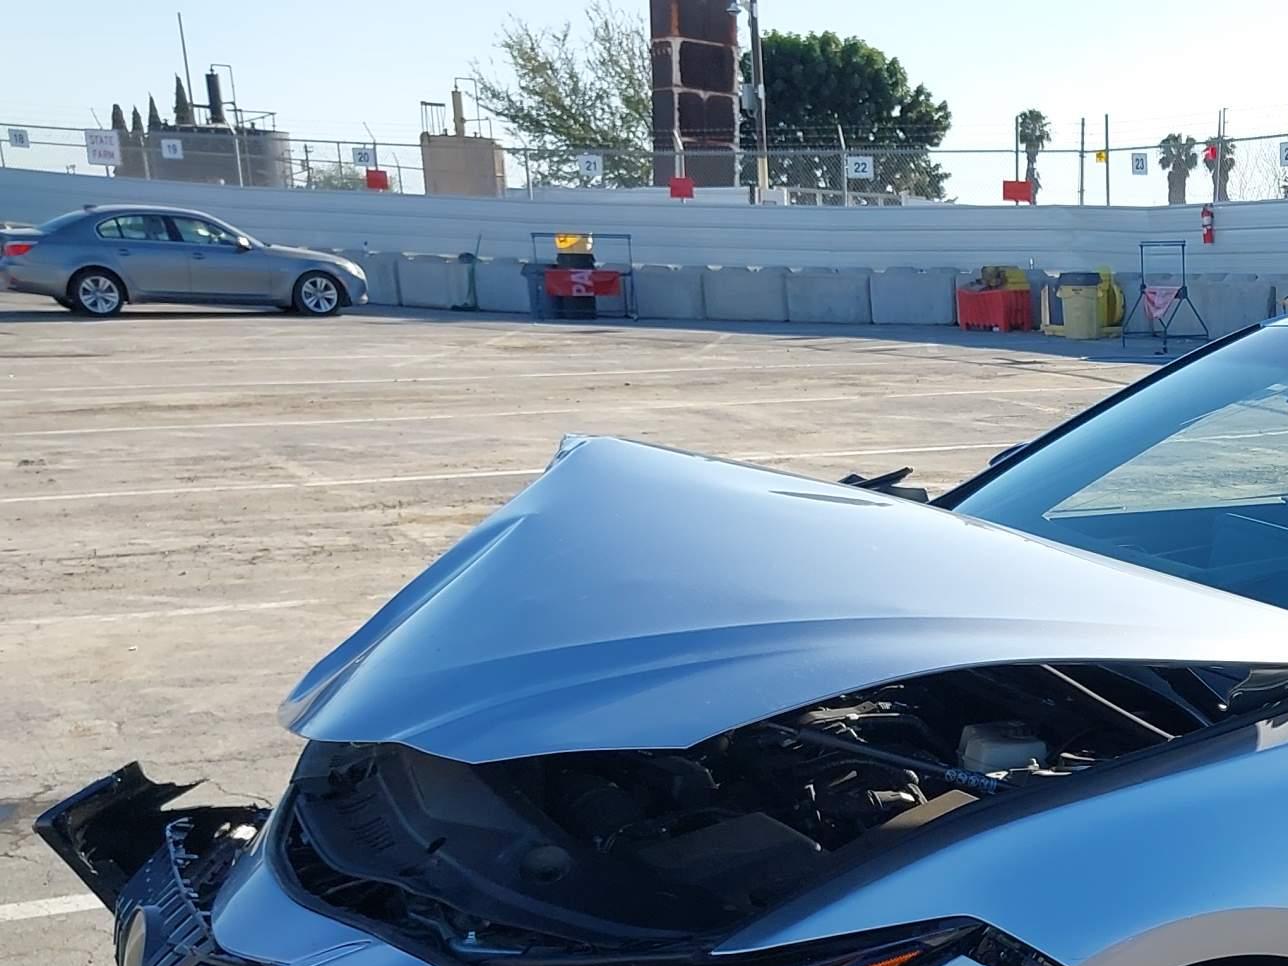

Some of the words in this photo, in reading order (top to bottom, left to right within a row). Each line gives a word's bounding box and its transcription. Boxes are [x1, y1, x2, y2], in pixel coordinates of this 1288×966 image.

[357, 151, 370, 163] 20
[584, 160, 597, 172] 21
[854, 161, 868, 173] 22
[1135, 158, 1145, 170] 23
